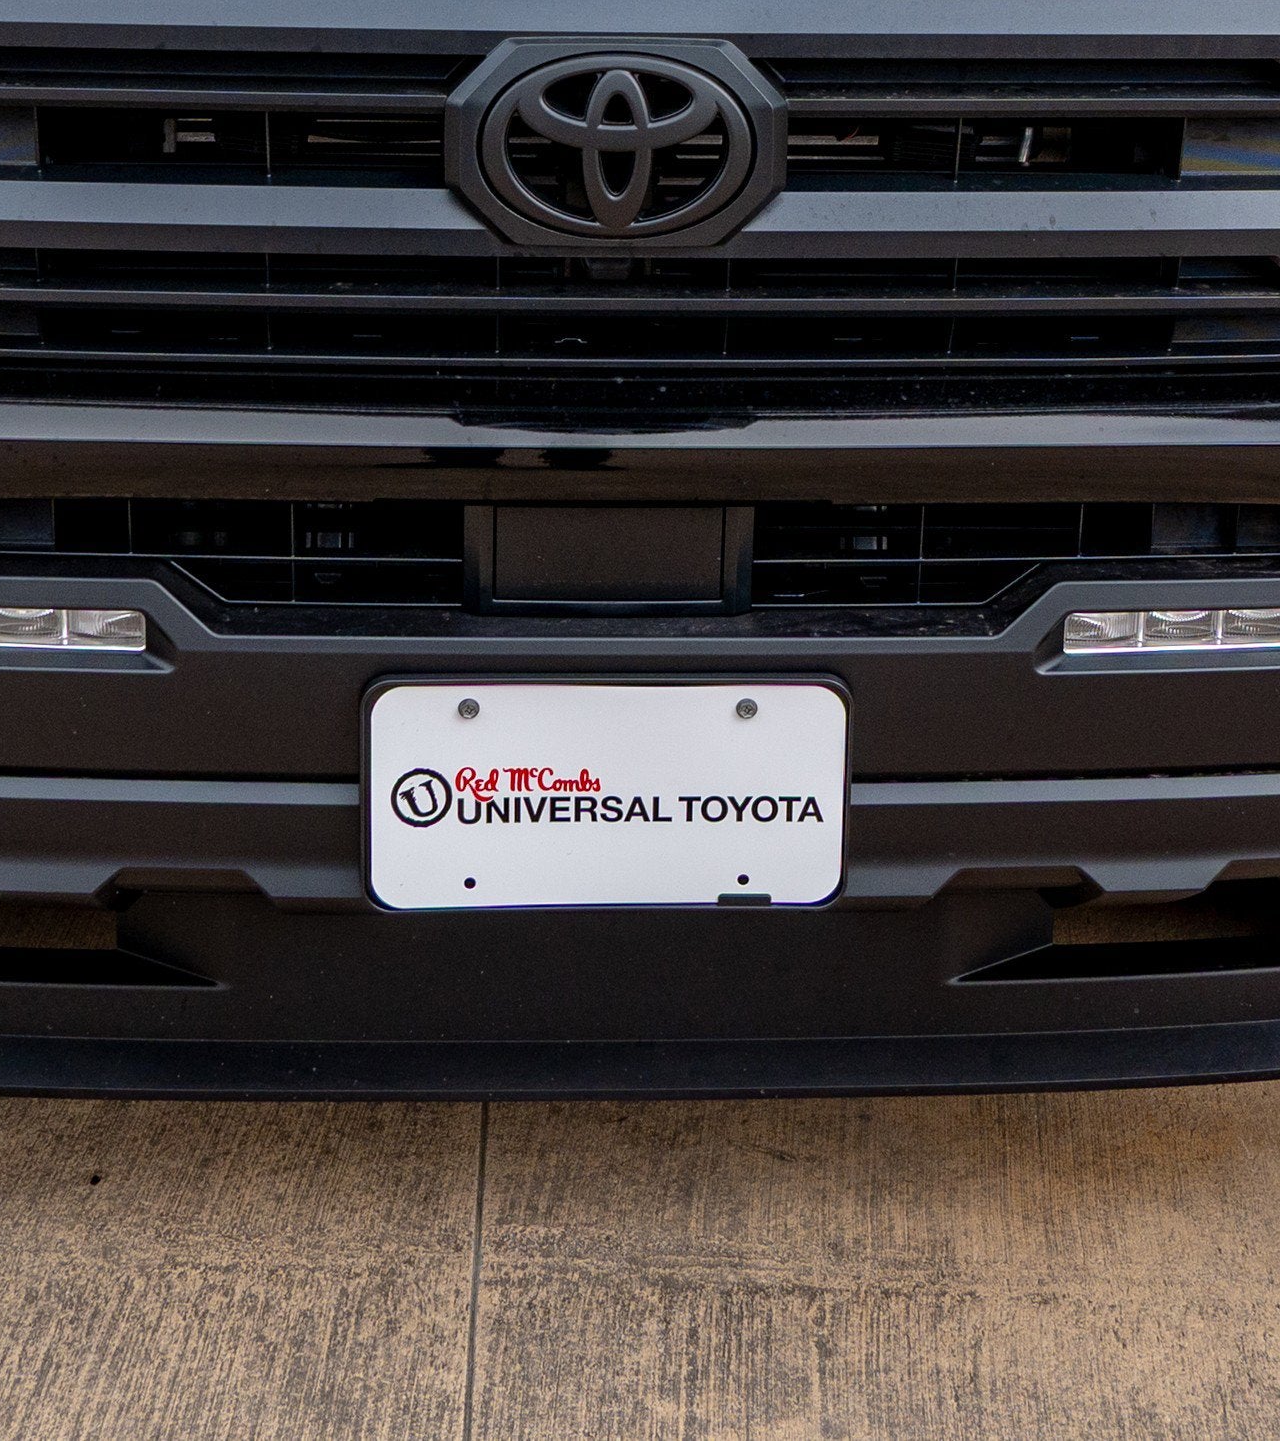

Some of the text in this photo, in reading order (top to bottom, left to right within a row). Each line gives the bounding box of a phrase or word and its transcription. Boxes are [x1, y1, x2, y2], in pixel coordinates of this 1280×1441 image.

[455, 766, 601, 802] Red McCombs
[457, 795, 824, 824] UNIVERSAL TOYOTA
